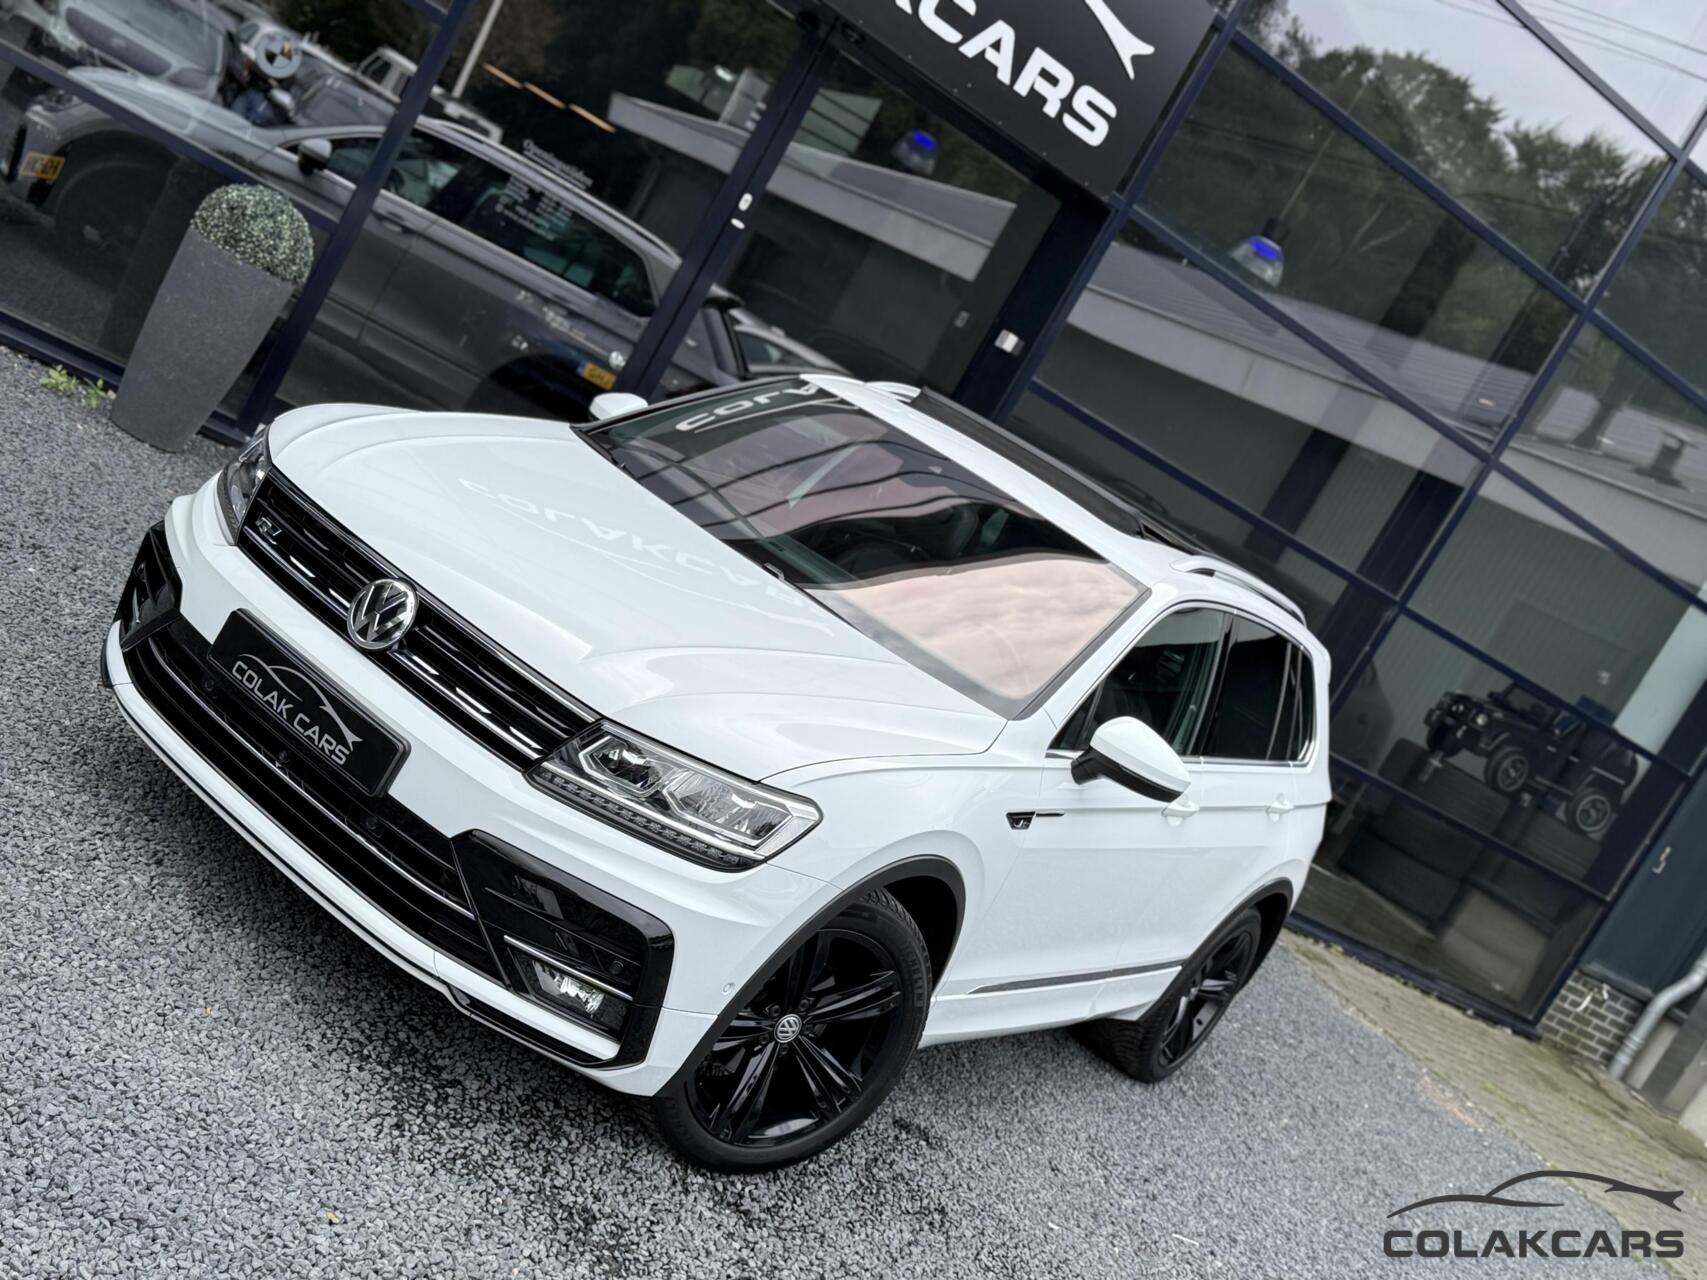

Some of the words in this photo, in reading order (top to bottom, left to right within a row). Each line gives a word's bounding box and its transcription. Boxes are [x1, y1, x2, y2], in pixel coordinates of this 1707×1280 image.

[895, 0, 1117, 147] CARS
[232, 661, 294, 720] COLAK
[293, 712, 350, 765] CARS
